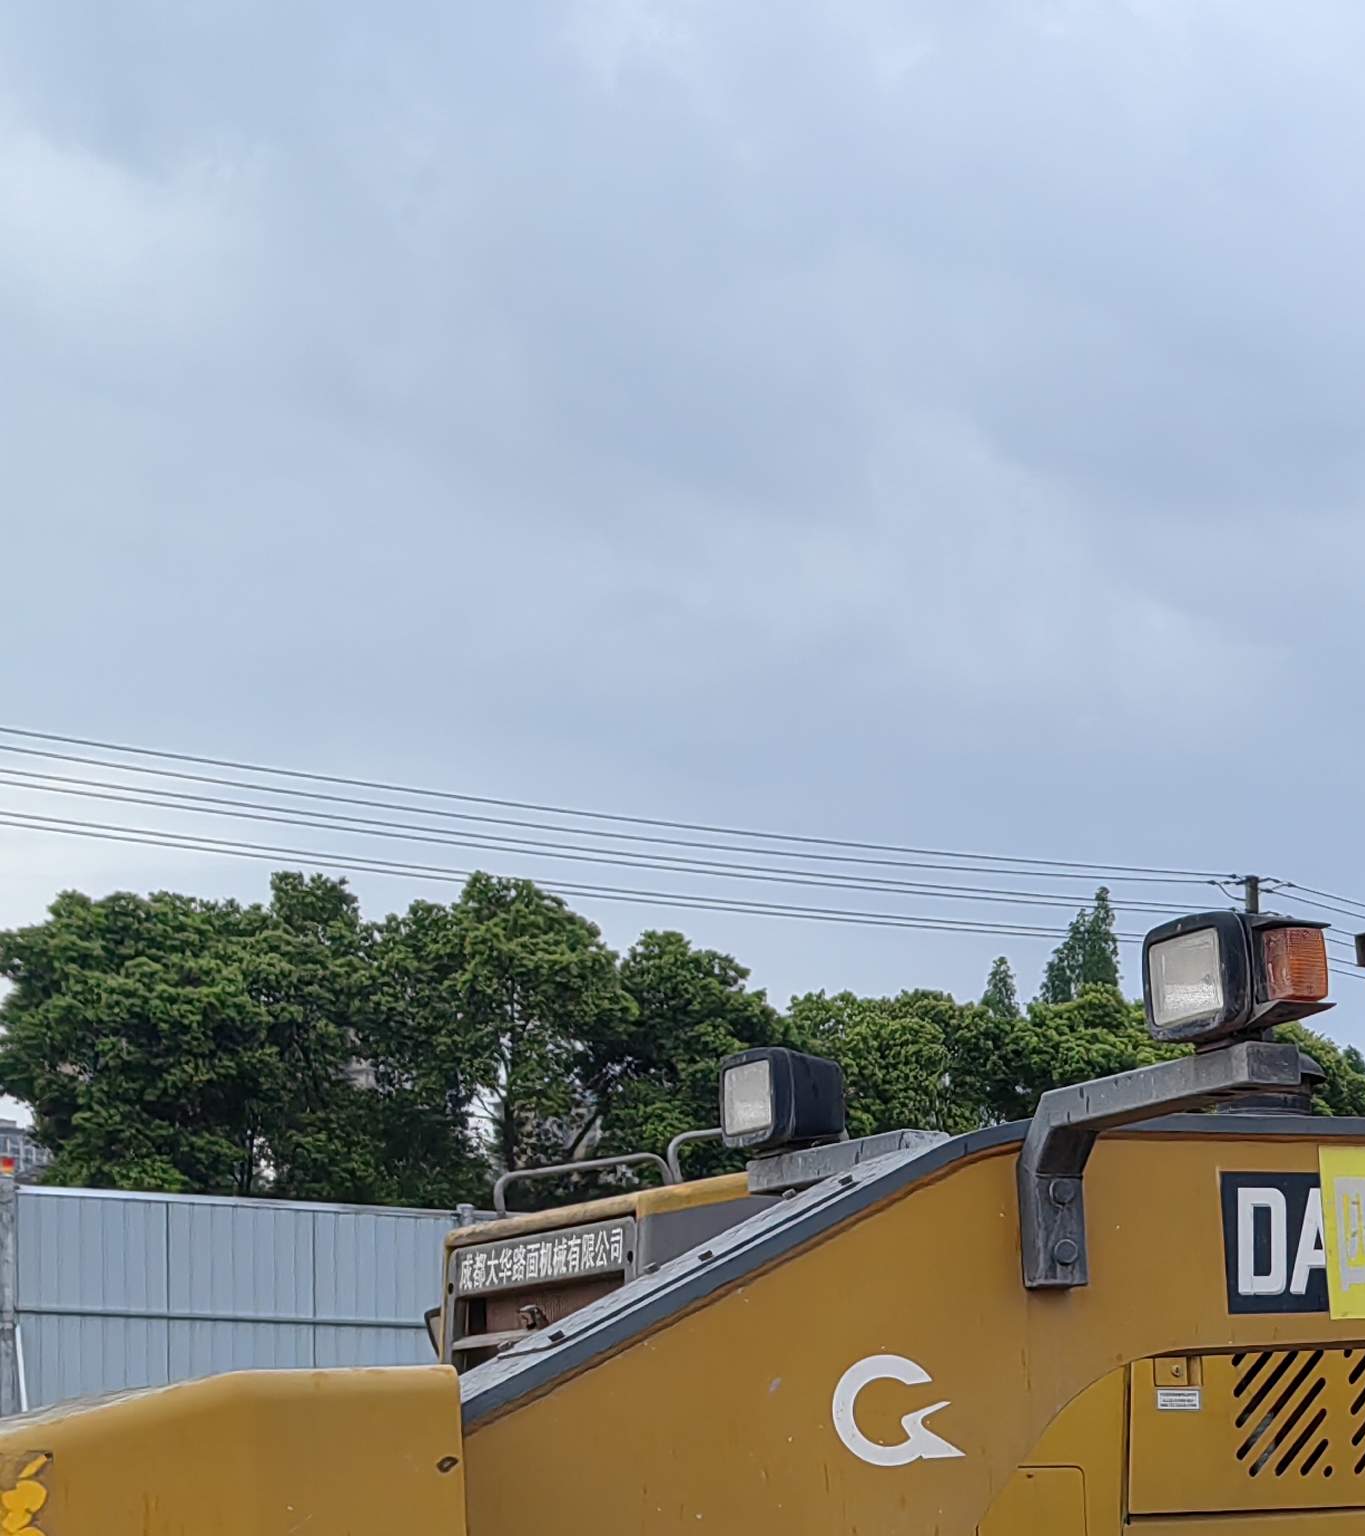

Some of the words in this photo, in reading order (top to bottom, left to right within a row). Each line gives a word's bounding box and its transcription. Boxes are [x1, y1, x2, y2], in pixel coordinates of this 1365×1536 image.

[459, 1227, 624, 1291] 成都大华路面机械有限公司
